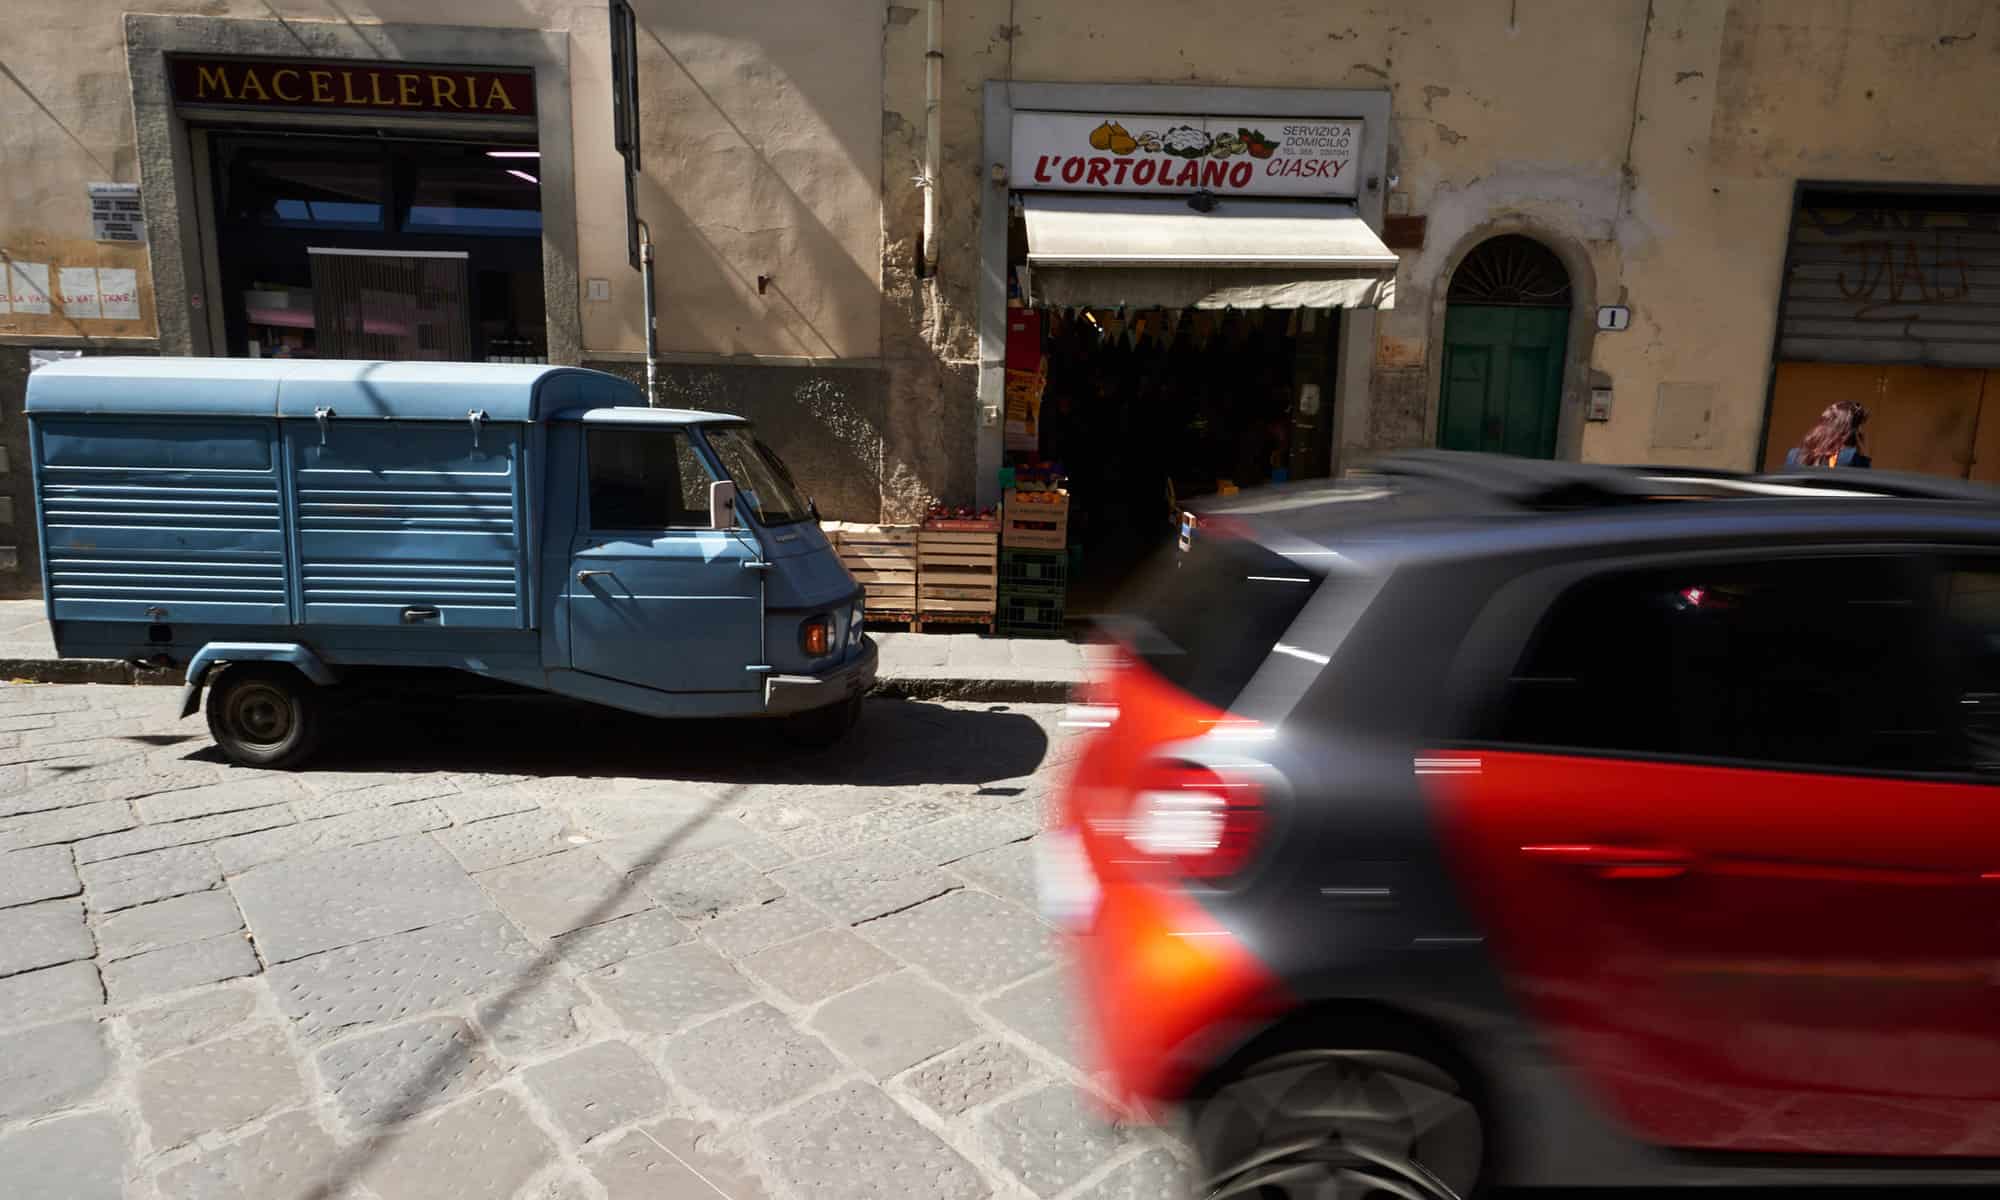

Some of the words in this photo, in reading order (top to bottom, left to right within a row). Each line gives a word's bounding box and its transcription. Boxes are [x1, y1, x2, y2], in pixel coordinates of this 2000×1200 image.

[197, 65, 518, 111] MACELLERIA
[1282, 125, 1340, 137] SERVIZIO
[1342, 127, 1352, 138] A
[1286, 137, 1350, 148] DOMICILIO
[1034, 155, 1254, 188] L'ORTOLANO
[1265, 158, 1349, 178] CIASKY
[1607, 309, 1617, 328] 1
